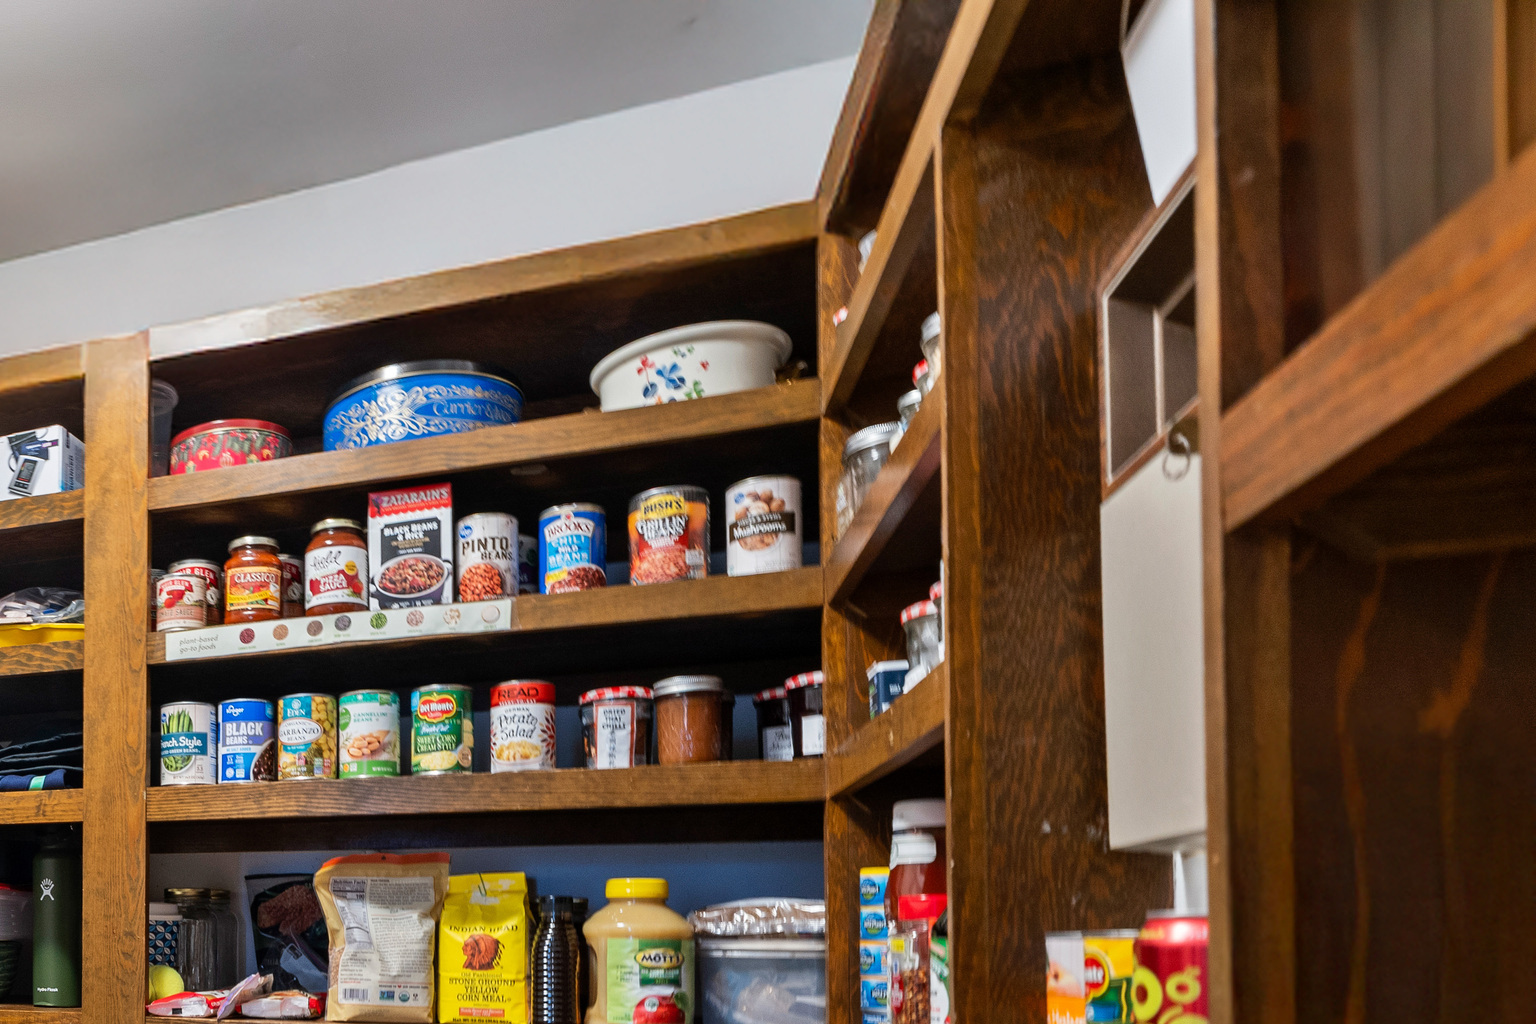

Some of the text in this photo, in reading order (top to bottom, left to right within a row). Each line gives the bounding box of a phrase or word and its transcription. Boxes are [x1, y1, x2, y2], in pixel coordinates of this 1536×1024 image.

[644, 500, 683, 515] BUSH'S
[384, 521, 439, 537] BLACK BEANS
[547, 522, 591, 537] BROOKS
[644, 526, 685, 540] BEANS
[733, 521, 787, 540] Mushrooms
[462, 537, 509, 555] PINTO
[551, 537, 585, 548] CHILI
[481, 551, 513, 561] BEANS
[548, 551, 588, 564] BEANS
[193, 567, 215, 579] GLEN
[234, 573, 276, 583] CLASSICO
[320, 573, 345, 585] PIZZA
[319, 580, 348, 592] SAUCE
[179, 635, 219, 646] plant-based
[197, 644, 217, 654] foods
[498, 687, 539, 697] READ
[287, 708, 305, 717] EDEN
[420, 702, 454, 713] Del Monte
[353, 711, 388, 719] CANNELLINI
[497, 711, 539, 728] Potato
[225, 722, 263, 736] BLACK
[500, 726, 537, 741] Salad
[179, 736, 203, 749] Style
[225, 736, 248, 745] BEANS
[417, 734, 457, 744] SWEET CORN
[417, 740, 456, 752] CREAM STYLE
[449, 925, 486, 933] INDIAN
[449, 977, 516, 986] STONE GROUND
[465, 986, 500, 994] YELLOW
[457, 993, 507, 1003] CORN MEAL
